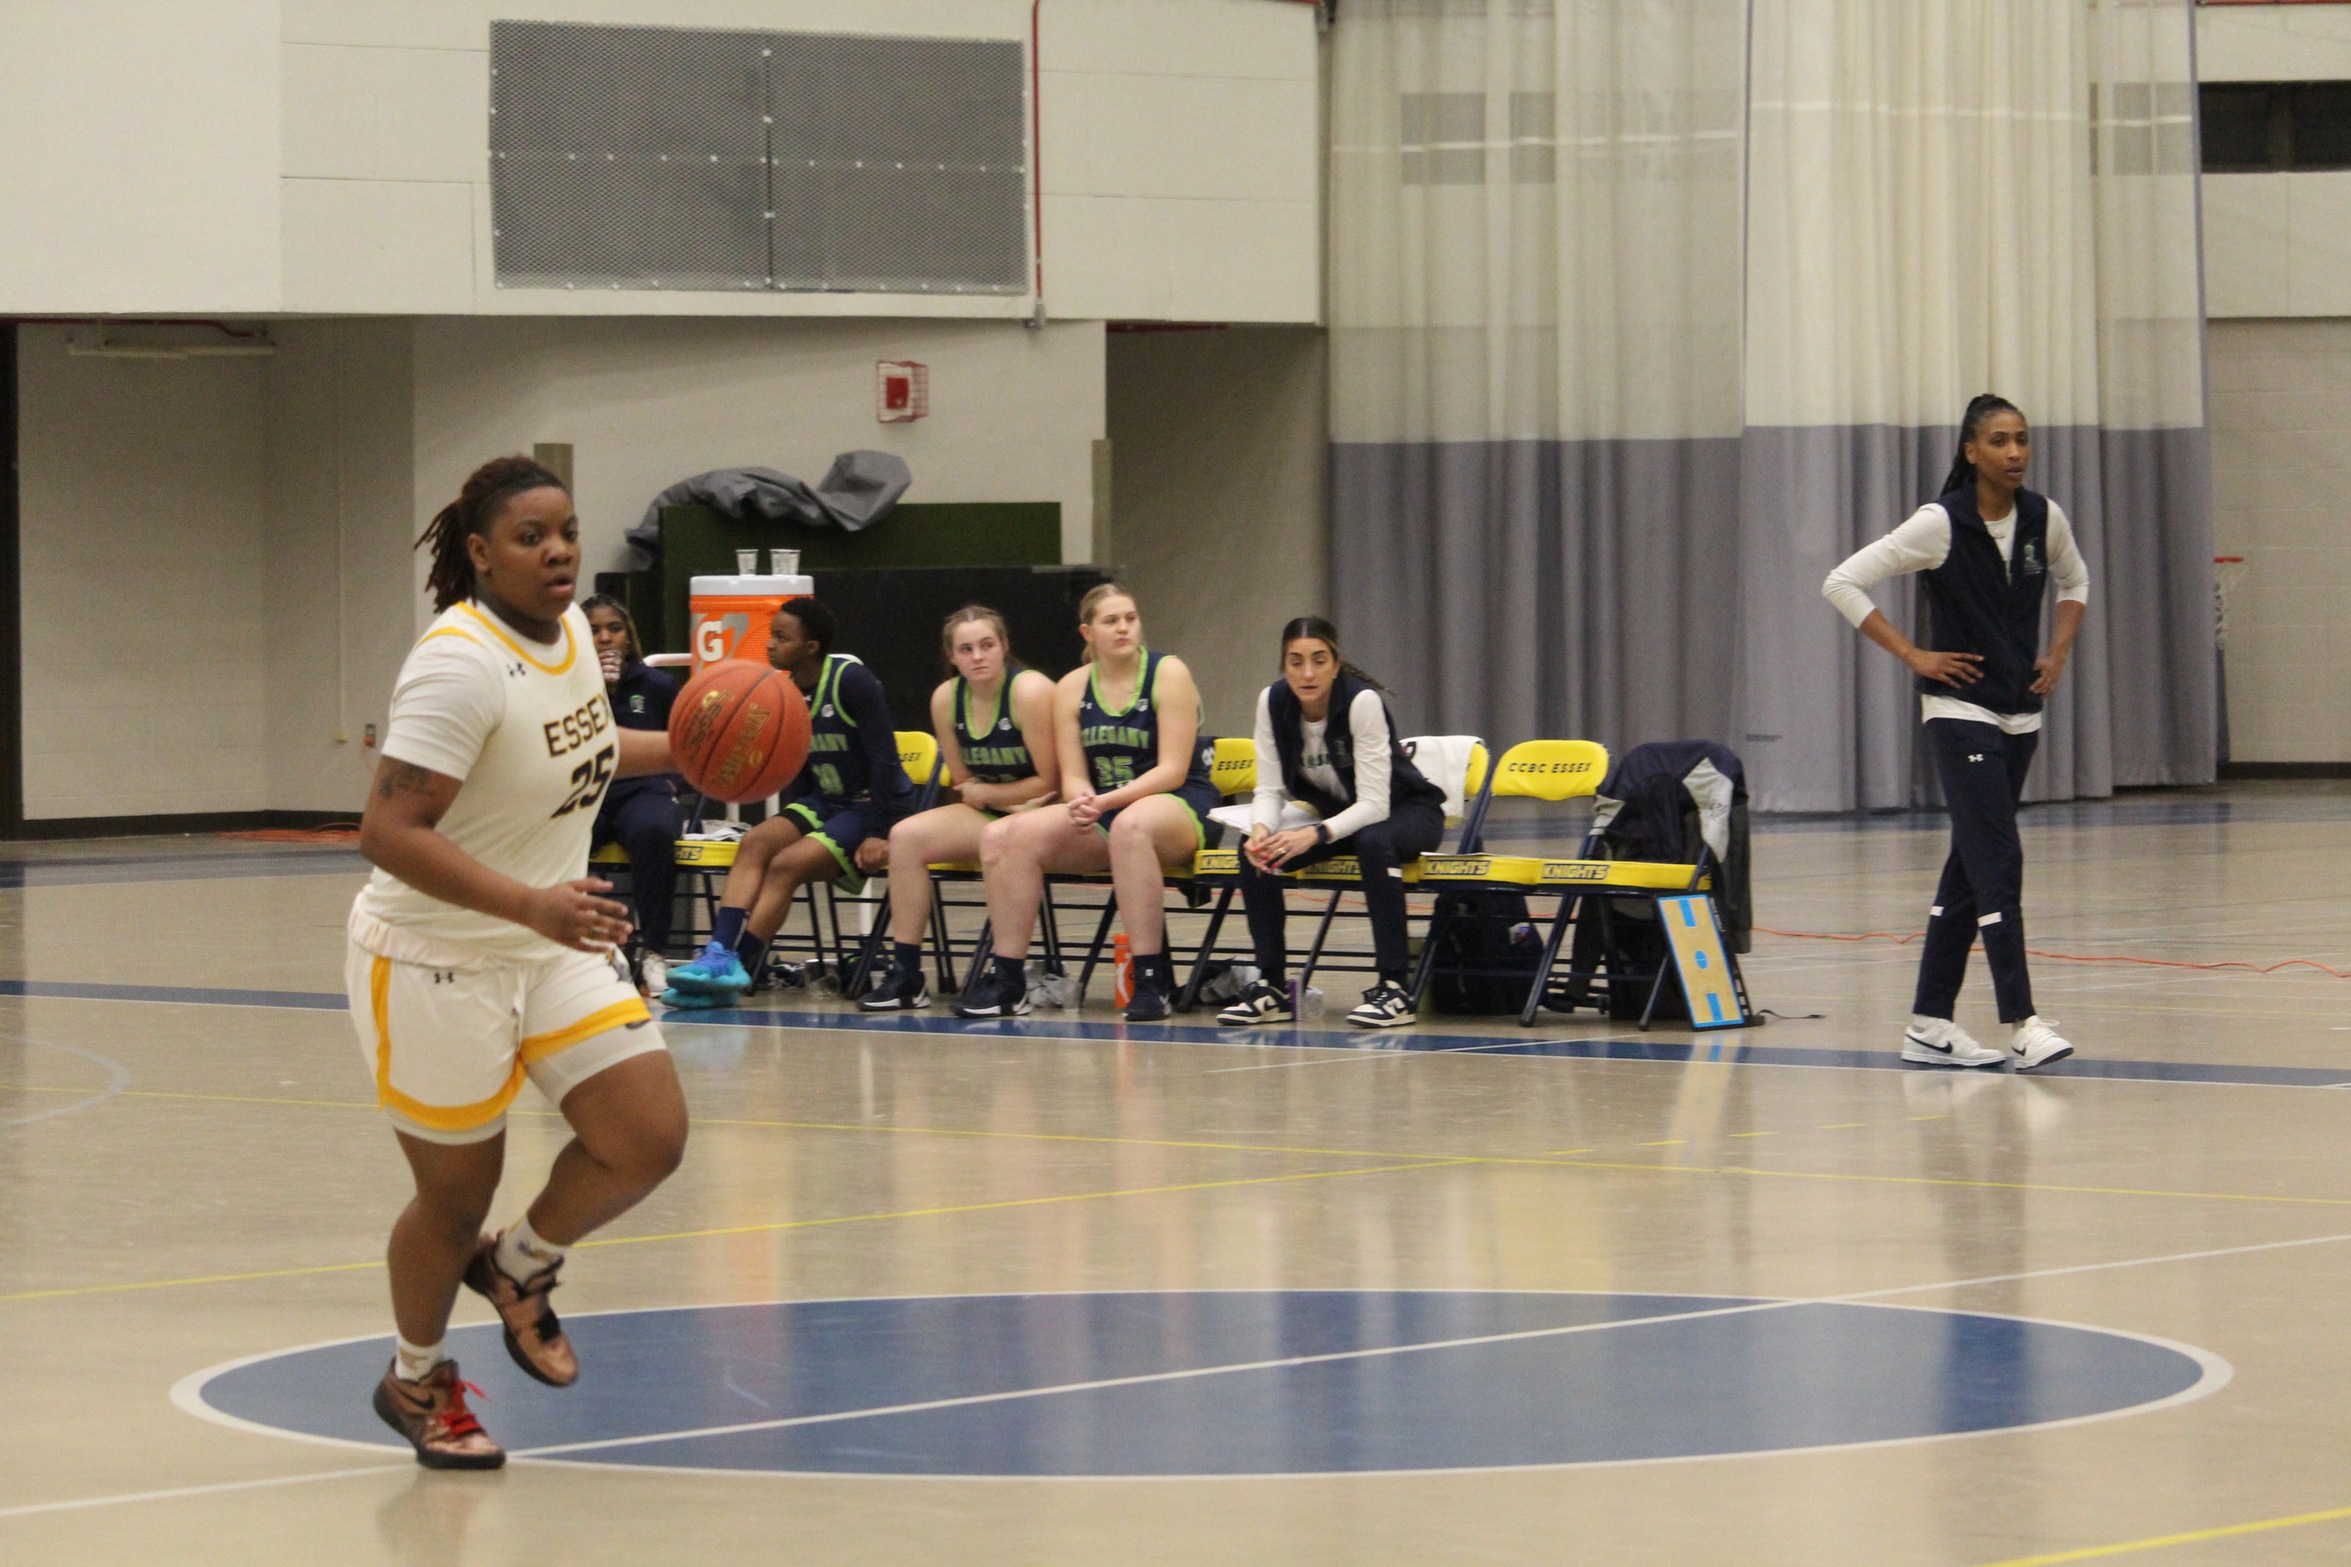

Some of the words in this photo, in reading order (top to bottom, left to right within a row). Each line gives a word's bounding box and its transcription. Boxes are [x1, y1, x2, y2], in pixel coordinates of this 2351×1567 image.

[697, 620, 723, 662] G
[1094, 755, 1135, 788] 35
[1216, 759, 1254, 771] ESSEX
[1508, 762, 1547, 773] CCBC
[1551, 762, 1593, 773] ESSEX
[549, 744, 614, 819] 25
[1424, 860, 1490, 875] KNIGHTS
[1543, 864, 1609, 879] KNIGHTS
